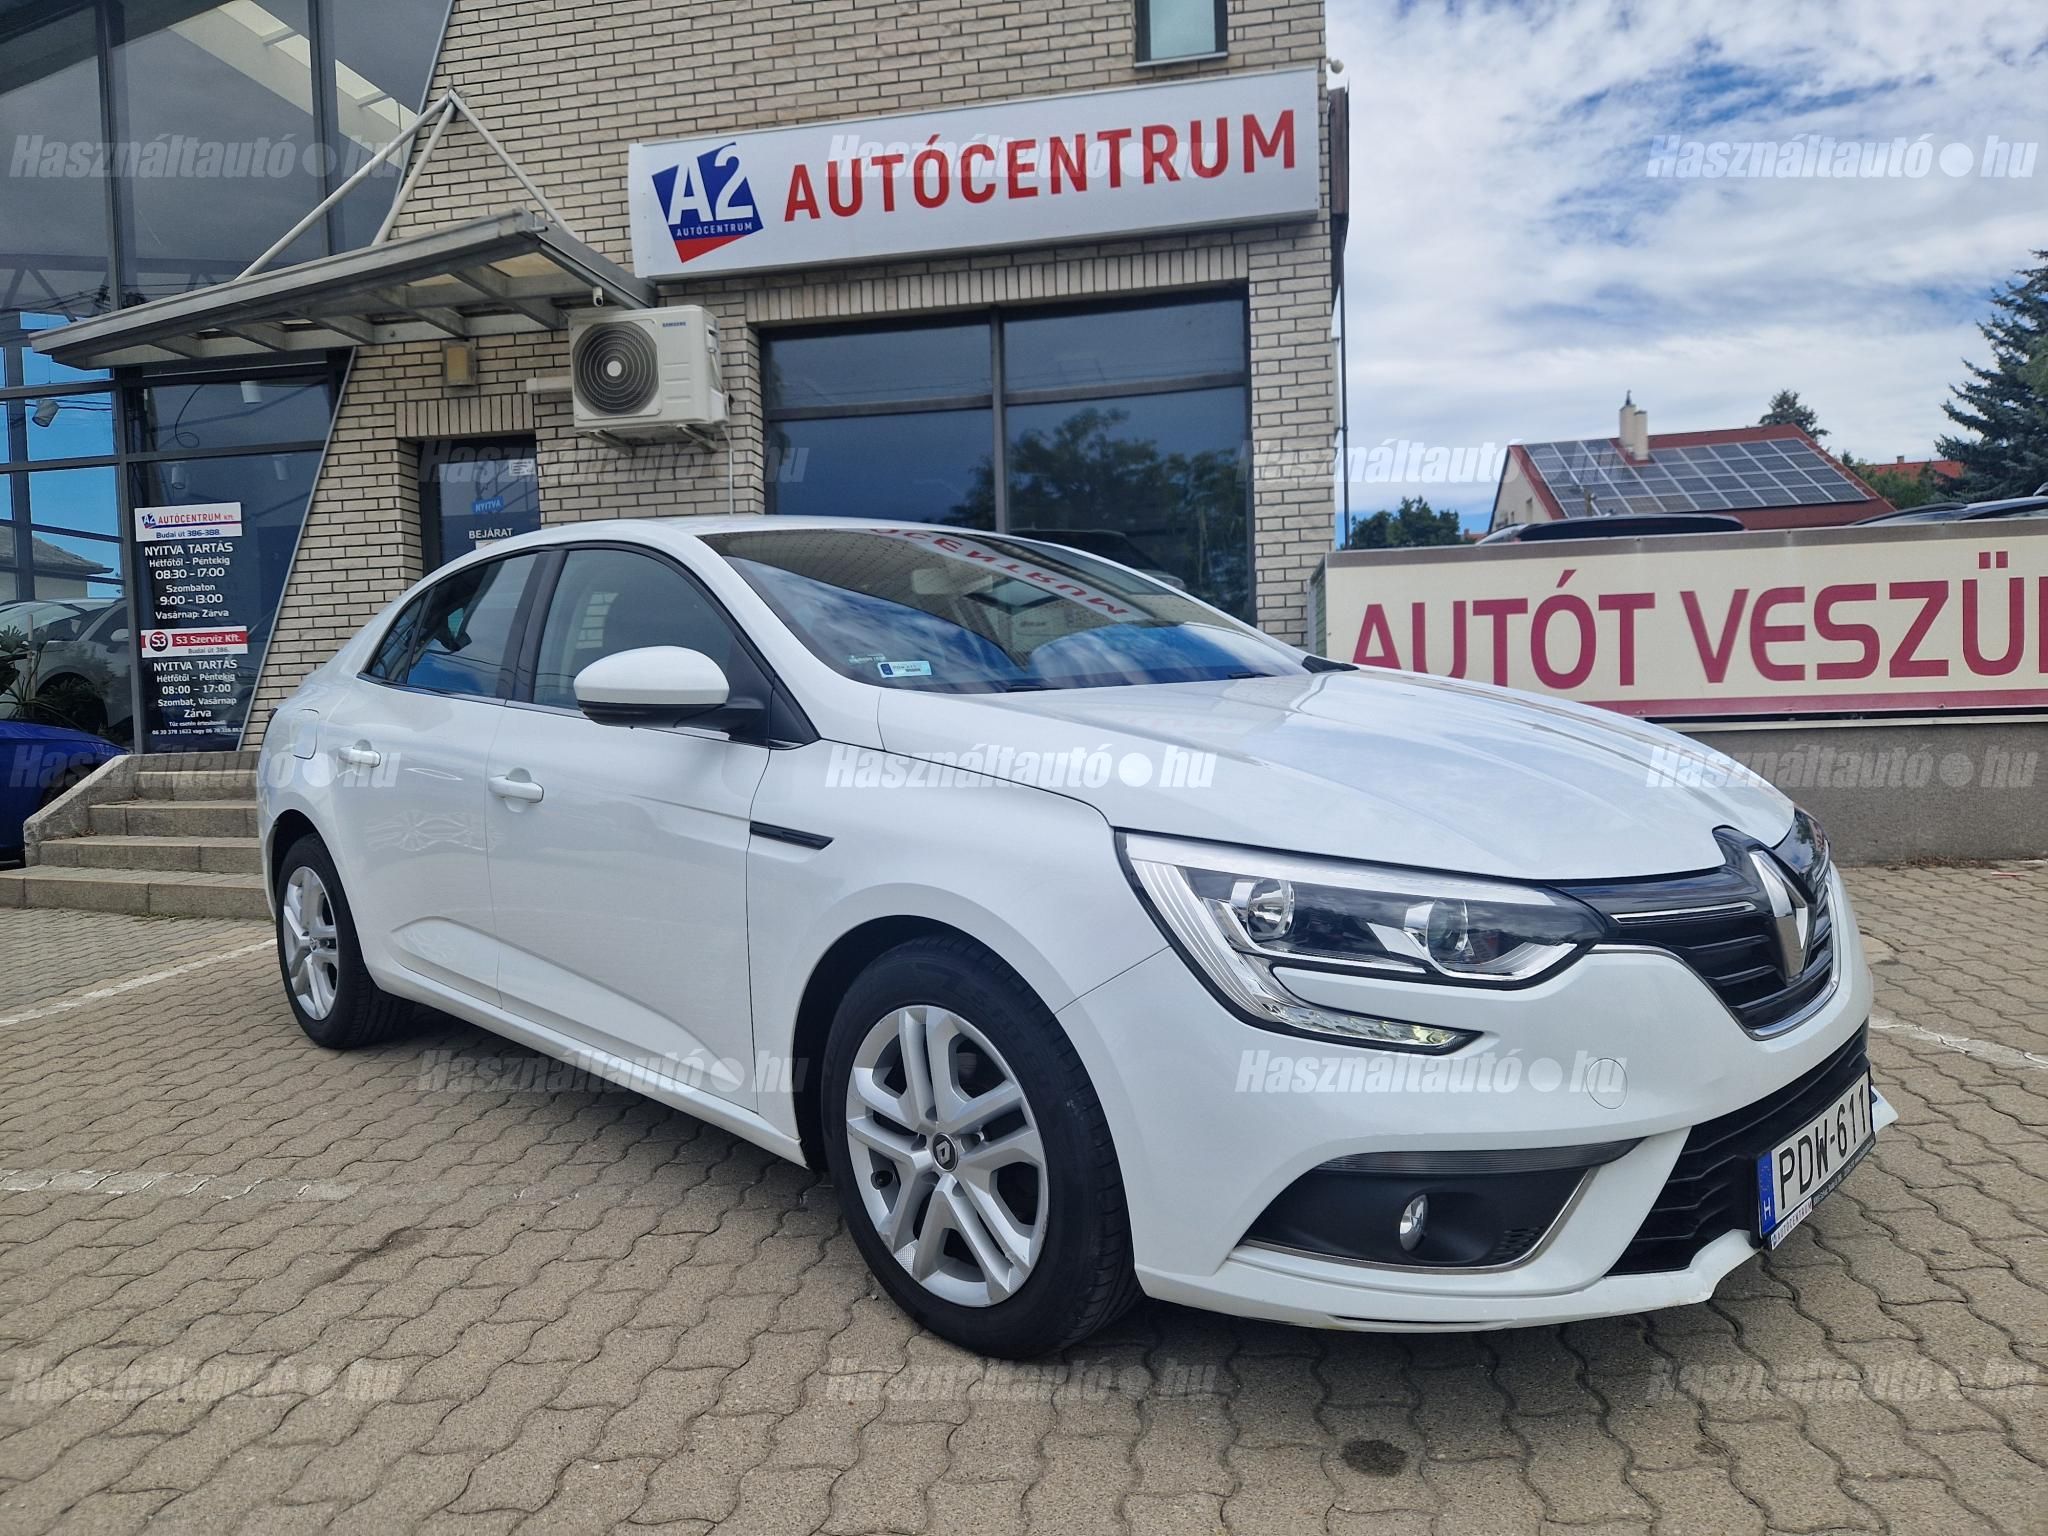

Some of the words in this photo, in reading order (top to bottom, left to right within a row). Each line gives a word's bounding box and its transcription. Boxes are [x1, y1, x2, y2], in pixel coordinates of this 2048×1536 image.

[784, 110, 1296, 223] AUTÓCENTRUM
[667, 143, 754, 226] A2
[475, 500, 502, 512] NYITVA
[468, 527, 513, 539] BEJÁRAT
[144, 545, 185, 557] NYITVA
[188, 540, 234, 554] TARTÁS
[149, 557, 184, 568] Hétfőtől
[192, 555, 231, 566] Péntekig
[197, 567, 225, 578] 17:00
[166, 583, 215, 593] Szombaton
[160, 595, 186, 606] 9:00
[195, 594, 223, 604] 13:00
[155, 610, 200, 620] Vasárnap:
[202, 608, 229, 618] Zárva
[1351, 568, 1656, 691] AUTÓT
[1680, 551, 2048, 685] VESZÜ
[151, 634, 167, 647] S3
[176, 636, 188, 645] S3
[190, 635, 223, 644] Szerviz
[225, 633, 242, 643] Kft.
[153, 661, 192, 672] NYITVA
[196, 657, 238, 670] TARTÁS
[156, 673, 189, 683] Hétfőtől
[199, 672, 235, 682] Péntekig
[162, 685, 191, 695] 08:00
[203, 684, 231, 693] 17:00
[157, 698, 196, 707] Szombat,
[198, 696, 237, 706] Vasárnap
[184, 708, 212, 718] Zárva
[1778, 1084, 1866, 1210] PDW-611
[1763, 1197, 1772, 1221] H
